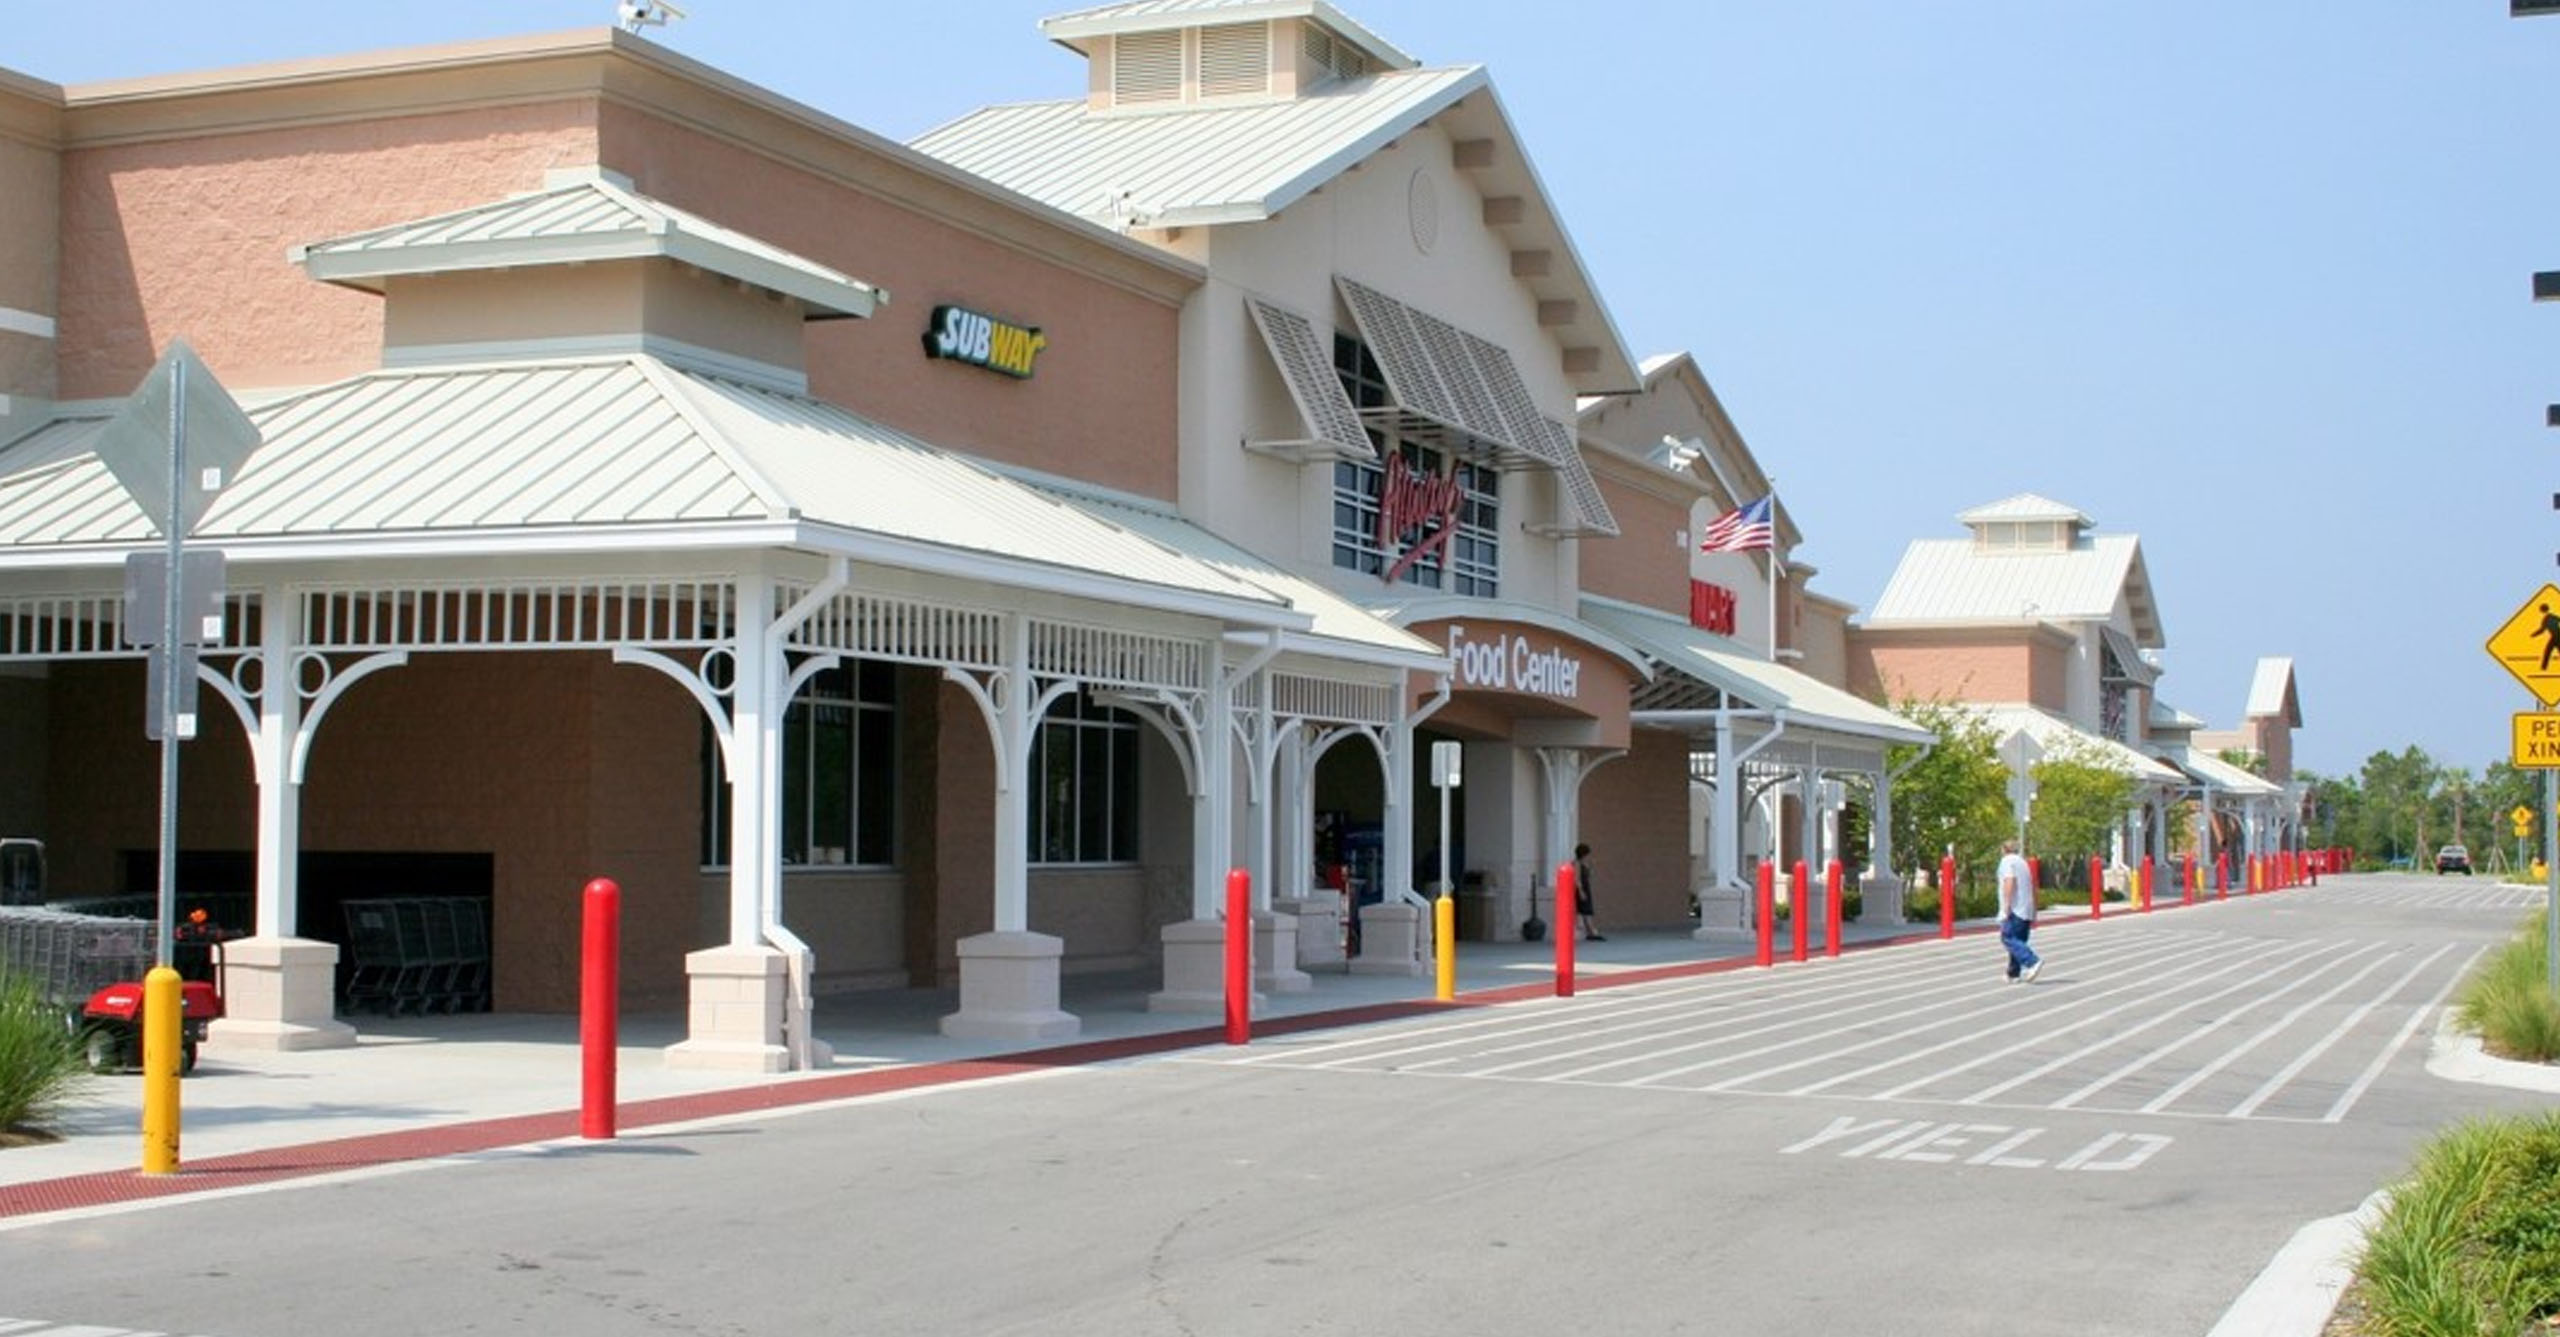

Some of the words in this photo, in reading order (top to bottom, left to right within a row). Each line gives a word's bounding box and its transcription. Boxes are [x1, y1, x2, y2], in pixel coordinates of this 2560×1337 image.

[938, 306, 1047, 373] SUBWAY
[1448, 624, 1506, 688] Food
[1512, 636, 1580, 697] Center
[2528, 740, 2560, 758] XIN
[2531, 720, 2560, 738] PE
[1778, 1116, 2175, 1171] YIELD
